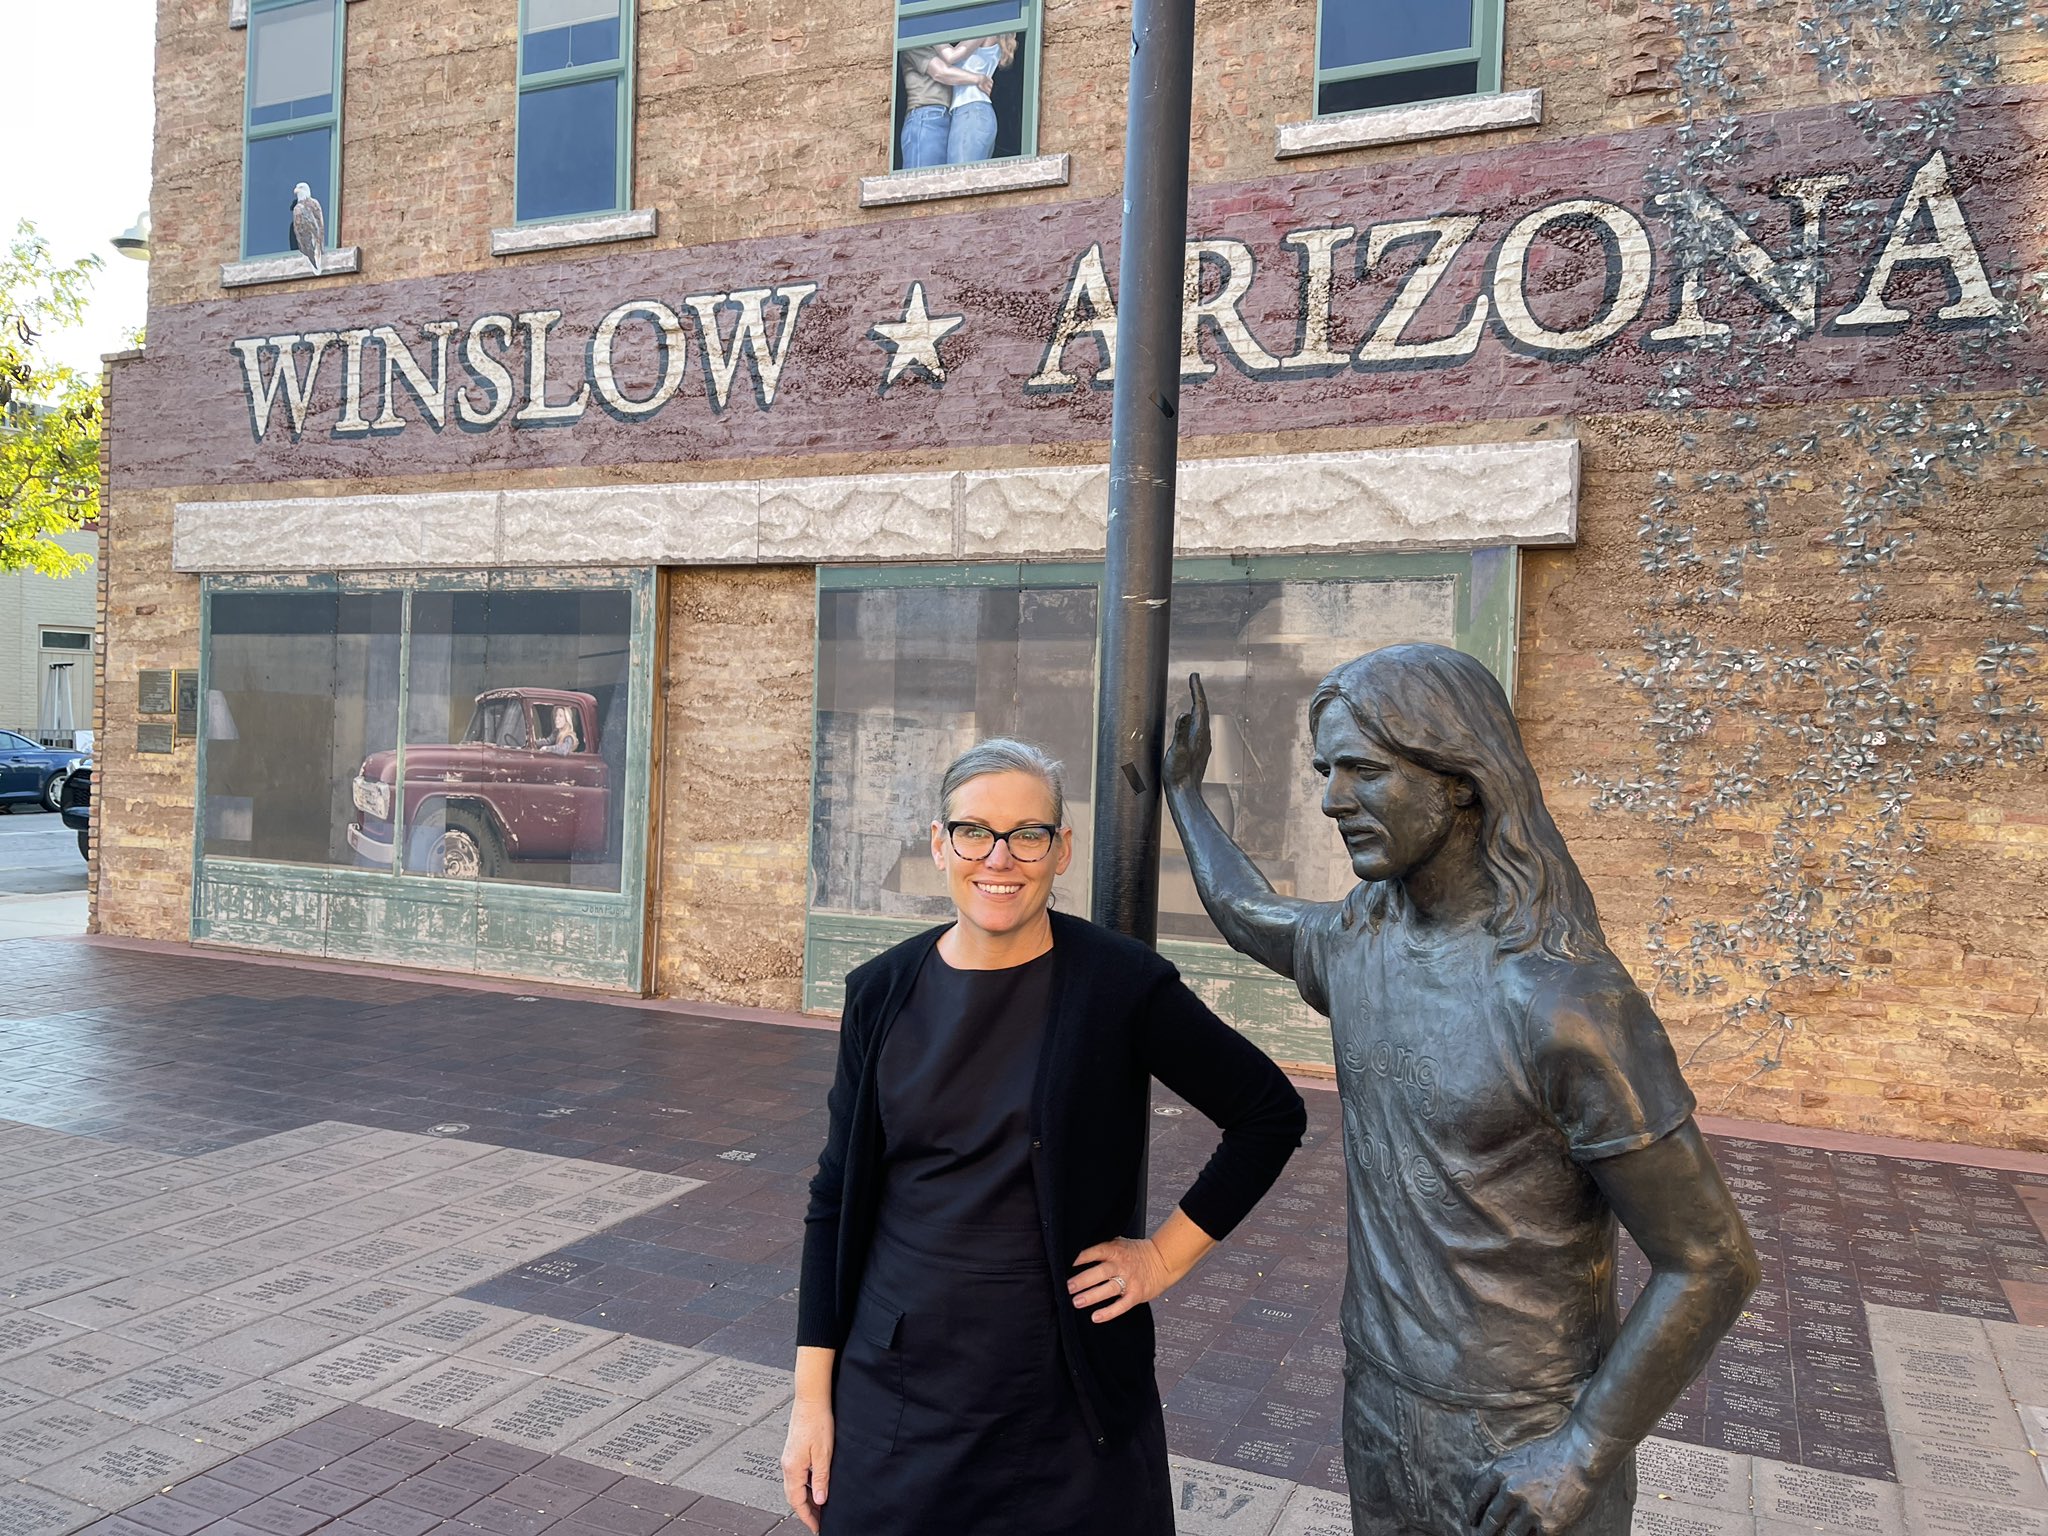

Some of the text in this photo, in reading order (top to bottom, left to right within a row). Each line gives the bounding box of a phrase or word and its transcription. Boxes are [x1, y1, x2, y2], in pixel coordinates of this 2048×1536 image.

[230, 149, 2004, 439] WINSLOW ARIZONA
[553, 1260, 578, 1268] GOD
[525, 1265, 572, 1279] AMERICA
[1260, 1308, 1293, 1318] TODD
[539, 1389, 607, 1409] VIETNAM VETERAN
[548, 1386, 583, 1397] THOMAS
[537, 1406, 559, 1414] LOVE
[573, 1403, 594, 1411] OUR
[218, 1418, 260, 1432] ENGLAND
[643, 1413, 714, 1435] CLAYTON SENIOR
[657, 1411, 714, 1428] THE BELTONS
[198, 1425, 223, 1434] MOM
[227, 1433, 249, 1442] DAD
[489, 1423, 513, 1432] JUNE
[624, 1427, 661, 1439] ROBERT
[630, 1422, 702, 1443] WHS GRADUATES
[645, 1420, 700, 1436] RUTH MOM
[619, 1432, 661, 1445] CLAYTON
[125, 1444, 145, 1452] THE
[595, 1444, 627, 1455] JOYCE
[604, 1440, 642, 1453] BURTON
[1666, 1444, 1685, 1452] PAY
[1687, 1448, 1728, 1461] HOMAGE
[143, 1456, 170, 1467] MARY
[584, 1447, 629, 1462] WINSLOW
[741, 1450, 779, 1463] AUGUST
[1653, 1446, 1724, 1464] YOU OUR HIGH
[96, 1455, 159, 1478] STOOD ON THE
[101, 1450, 139, 1464] ROBERT
[142, 1464, 172, 1476] CHRIS
[1638, 1456, 1719, 1477] WITH VOICE AND
[1705, 1466, 1729, 1475] TRUE
[97, 1464, 137, 1479] CORNER
[732, 1467, 758, 1476] MOM
[763, 1475, 786, 1483] DAD
[1657, 1474, 1686, 1484] TOAST
[1669, 1467, 1690, 1476] AND
[1784, 1466, 1866, 1486] MARY AND BOB
[1638, 1474, 1716, 1495] WINSLOW HIGH
[1638, 1479, 1671, 1491] CLASS
[1774, 1473, 1878, 1498] OUR WEDDING WAS
[1778, 1479, 1875, 1502] MANY YEARS AGO
[1778, 1484, 1876, 1507] THE CELEBRATION
[1786, 1490, 1848, 1507] CONTINUES
[1311, 1501, 1343, 1513] ANDY
[1323, 1498, 1354, 1510] LOVI
[1777, 1498, 1835, 1514] DECEMBER
[1777, 1503, 1837, 1520] DECEMBER
[1803, 1498, 1852, 1512] THIS DAY
[1632, 1508, 1722, 1531] NORTH COUNTRY
[1646, 1521, 1683, 1533] PROUD
[1775, 1507, 1883, 1533] CONGRATULATIONS
[1330, 1524, 1353, 1534] PAU
